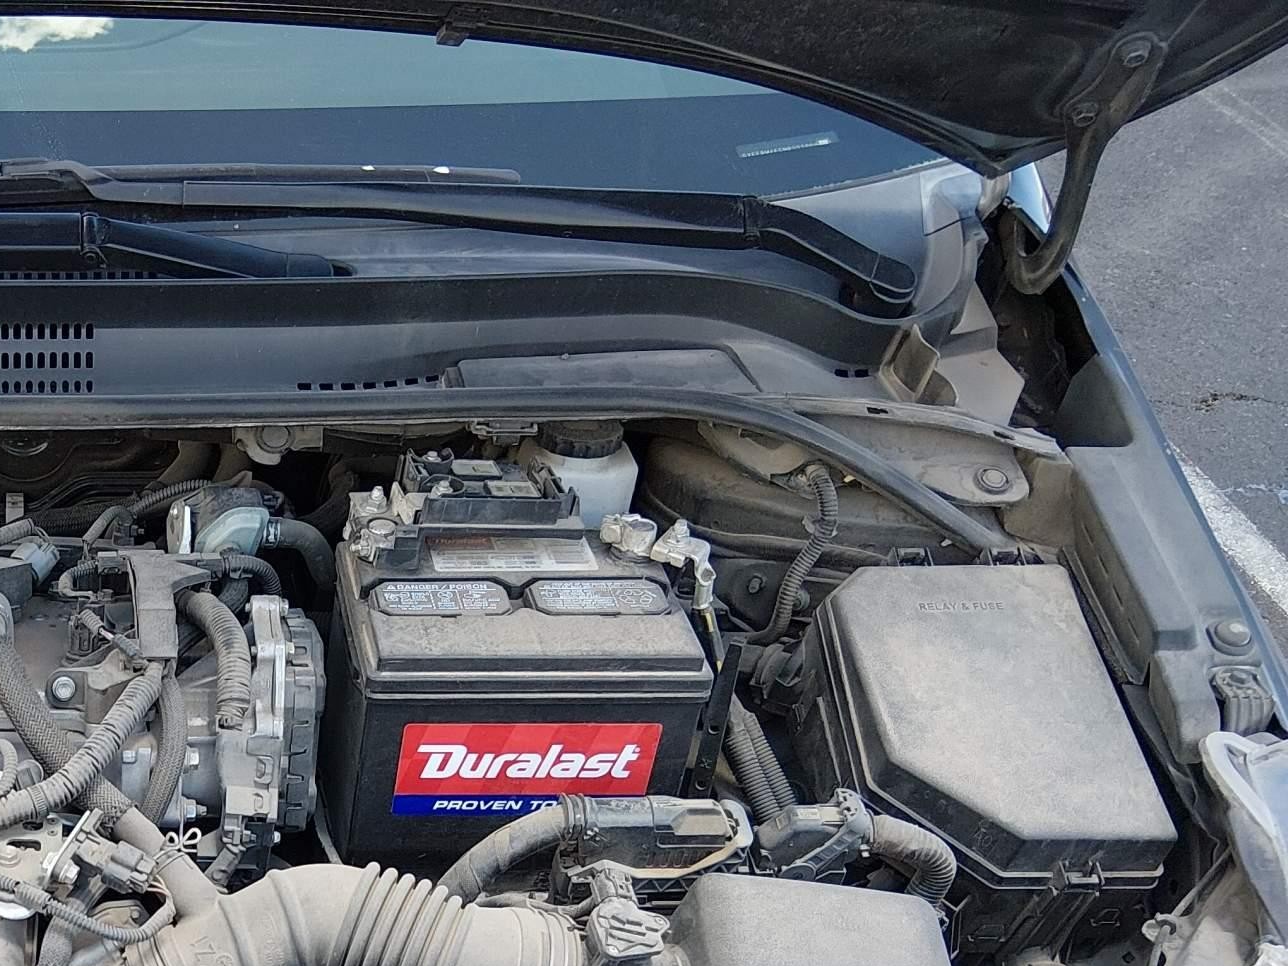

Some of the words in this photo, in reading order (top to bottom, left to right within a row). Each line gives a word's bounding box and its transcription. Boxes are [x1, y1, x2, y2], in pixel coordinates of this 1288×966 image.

[918, 602, 957, 611] RELAY
[961, 602, 970, 611] &
[972, 602, 1005, 611] FUSE
[416, 743, 641, 780] Duralast
[432, 800, 526, 811] PROVEN
